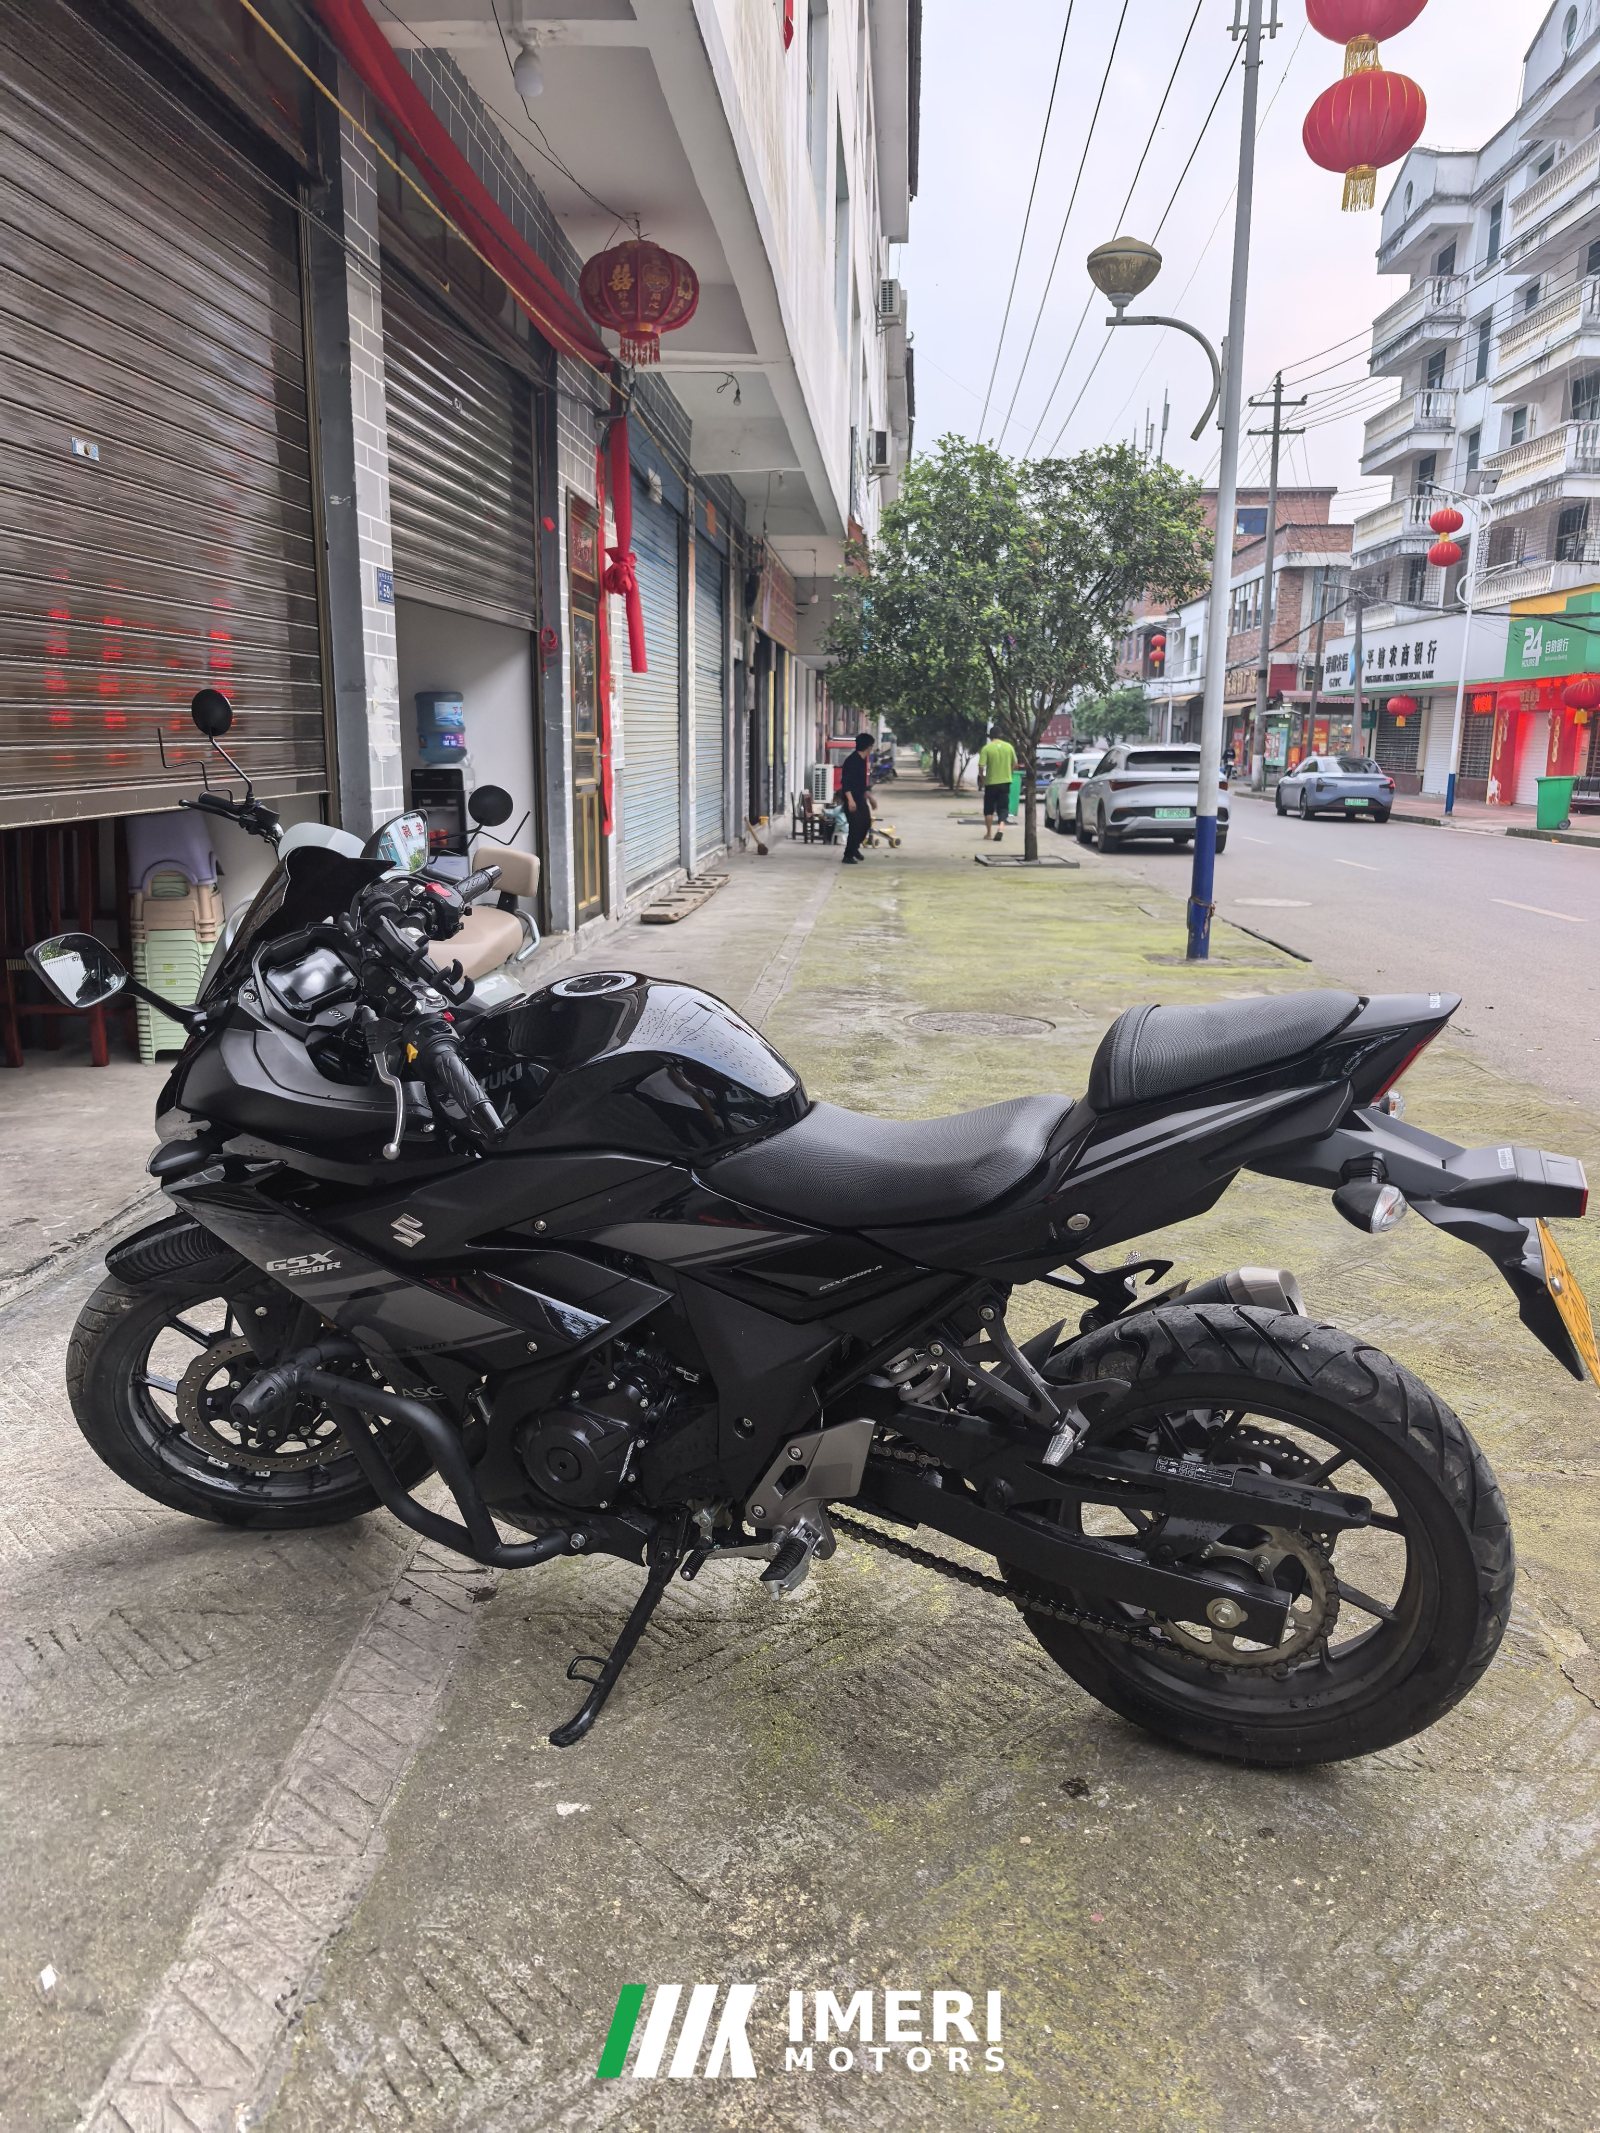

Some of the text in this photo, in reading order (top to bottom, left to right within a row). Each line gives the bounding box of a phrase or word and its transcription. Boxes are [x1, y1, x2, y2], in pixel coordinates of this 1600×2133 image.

[1545, 638, 1570, 654] 自助银行
[266, 1249, 337, 1272] GSX
